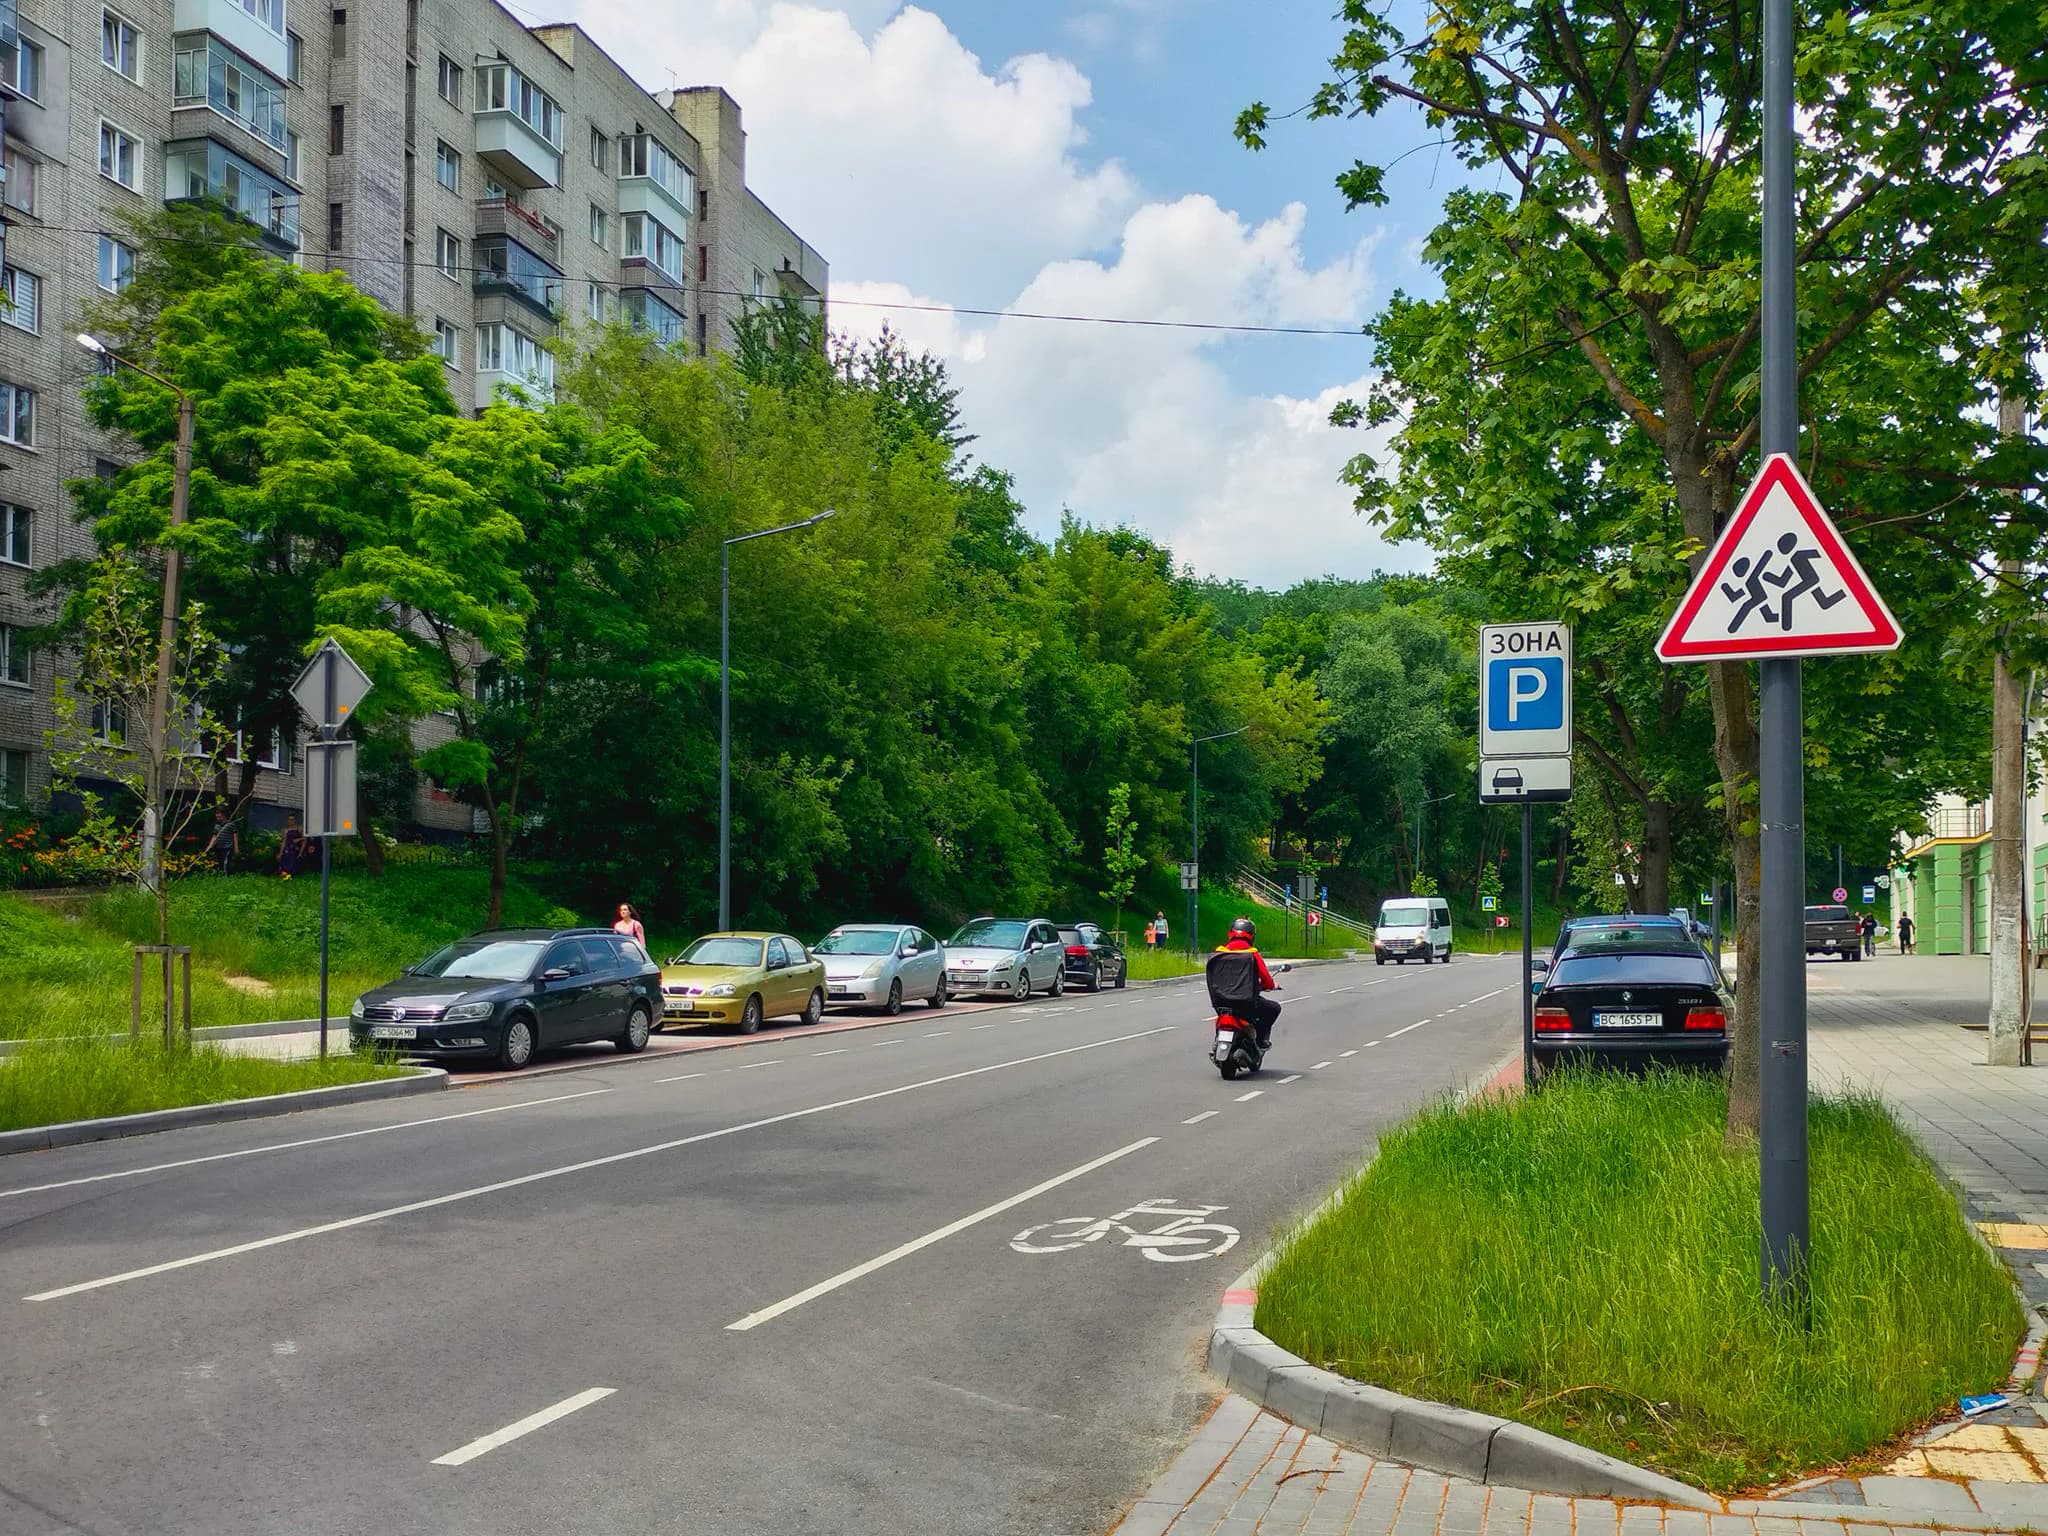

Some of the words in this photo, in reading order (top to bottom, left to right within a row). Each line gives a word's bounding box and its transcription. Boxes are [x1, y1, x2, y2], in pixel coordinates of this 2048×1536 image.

[1490, 631, 1562, 654] ЗОНА
[1509, 667, 1547, 722] P
[1600, 1014, 1616, 1025] BC
[1620, 1013, 1642, 1025] 1655
